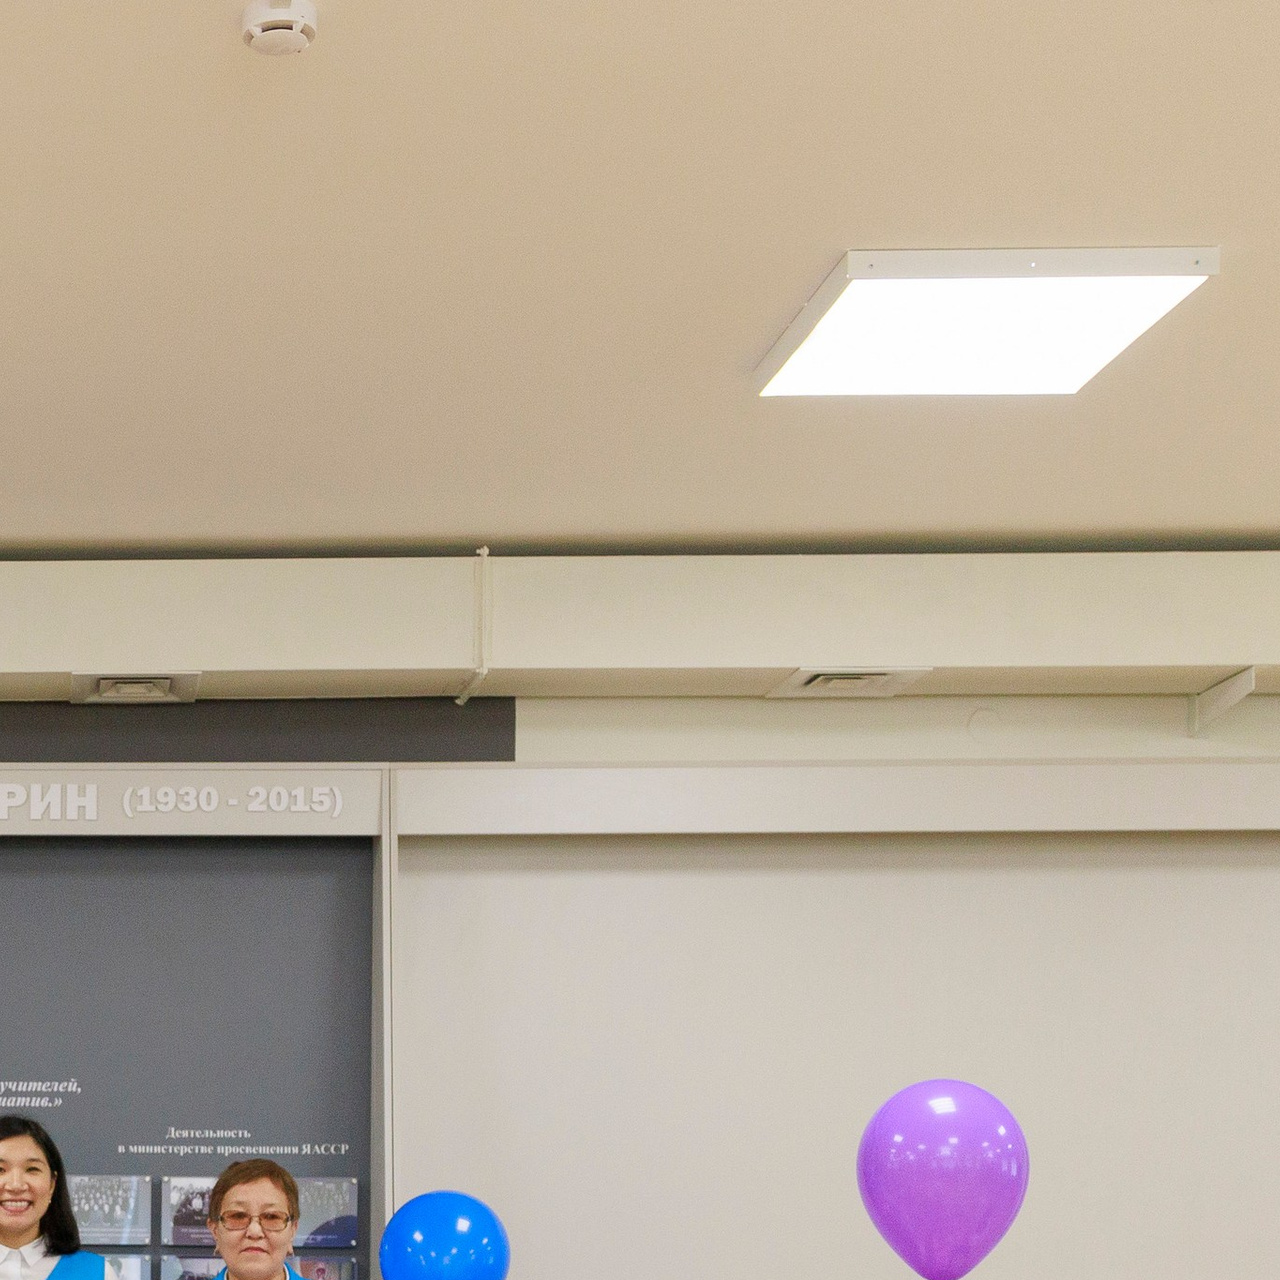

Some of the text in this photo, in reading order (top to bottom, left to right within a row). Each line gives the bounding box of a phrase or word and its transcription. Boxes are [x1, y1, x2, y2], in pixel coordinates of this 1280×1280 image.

[122, 785, 219, 818] (1930
[246, 785, 343, 818] 2015)
[165, 1126, 252, 1139] Деятельность
[129, 1144, 213, 1156] министерстве
[217, 1144, 299, 1157] просвещения
[302, 1143, 350, 1155] ЯАССР
